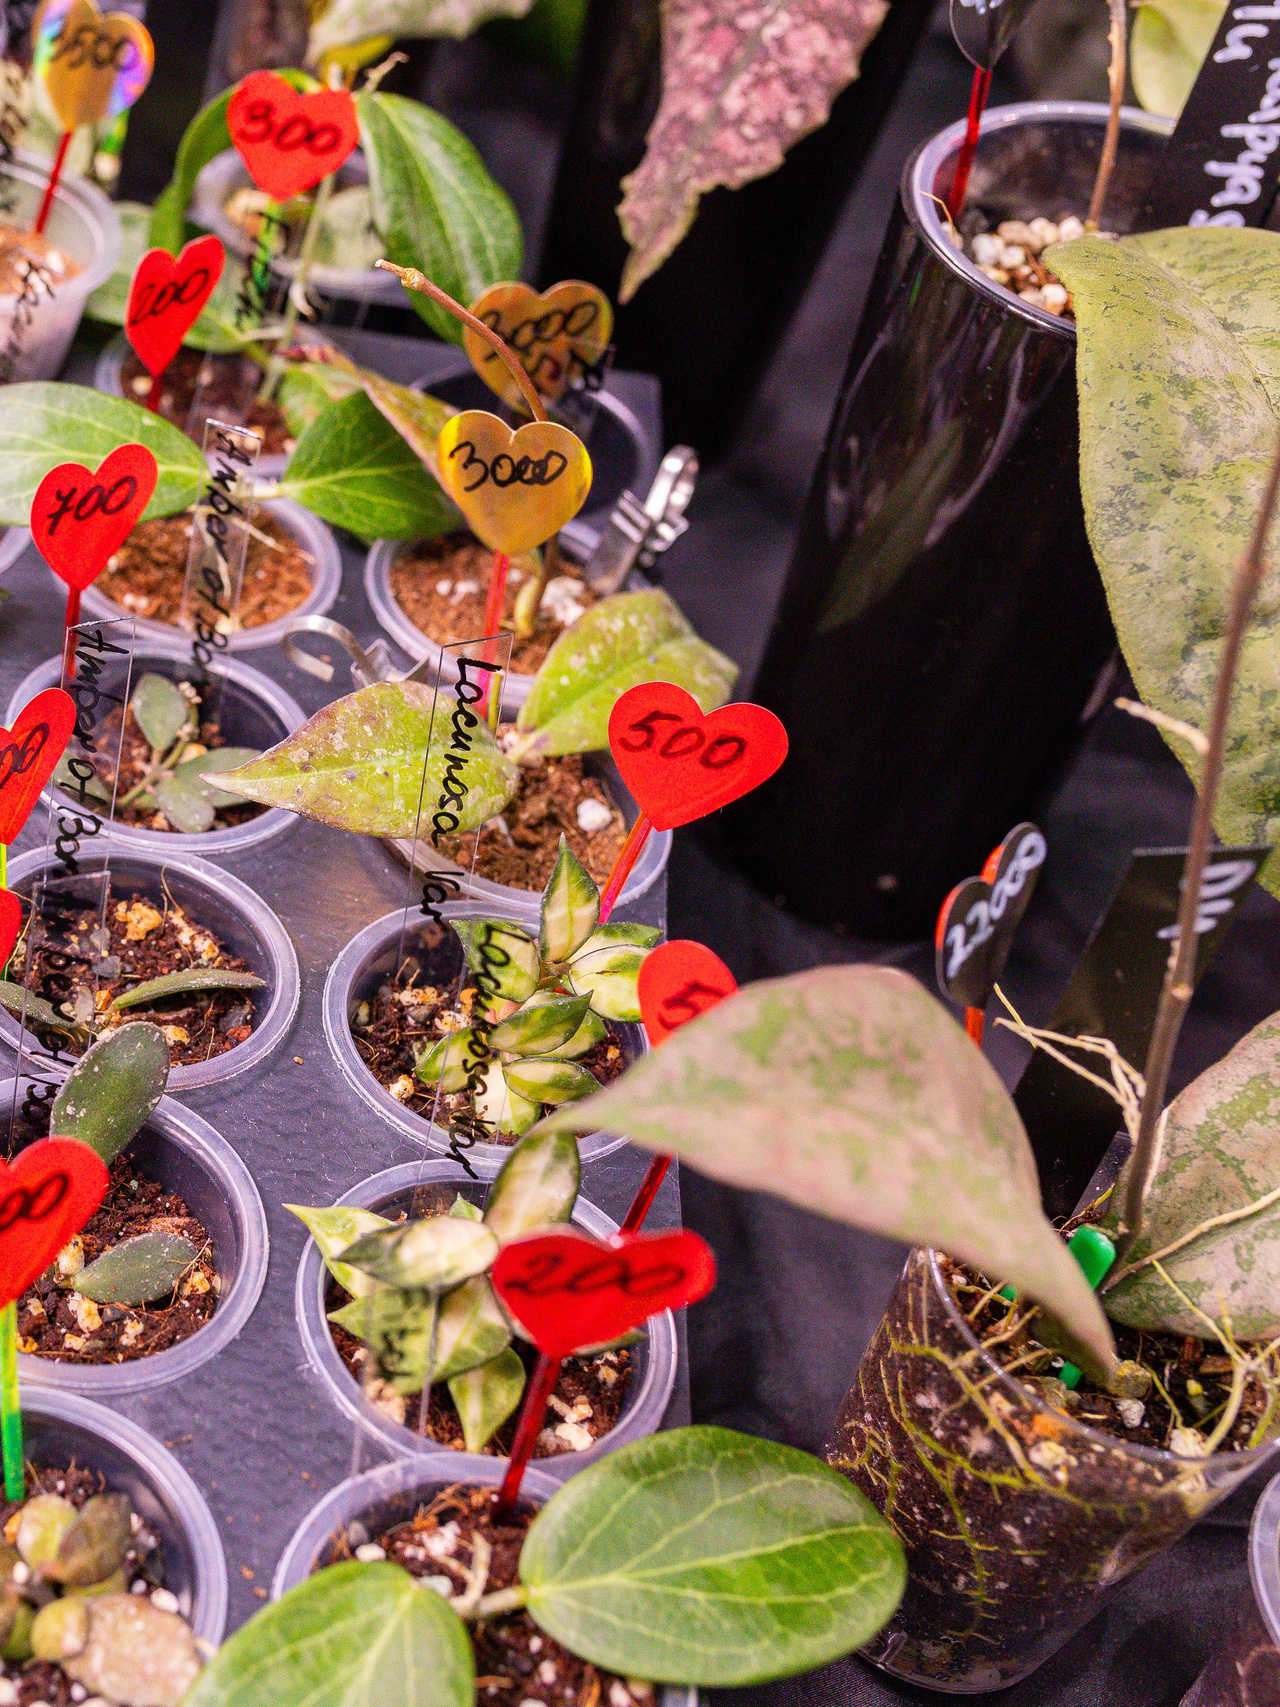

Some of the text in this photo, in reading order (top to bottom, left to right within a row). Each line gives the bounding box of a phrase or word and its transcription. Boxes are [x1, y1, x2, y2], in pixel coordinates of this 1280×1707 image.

[236, 100, 339, 156] 300
[46, 475, 138, 537] 700
[618, 710, 747, 769] 500
[418, 657, 504, 932] Lacunosa Var
